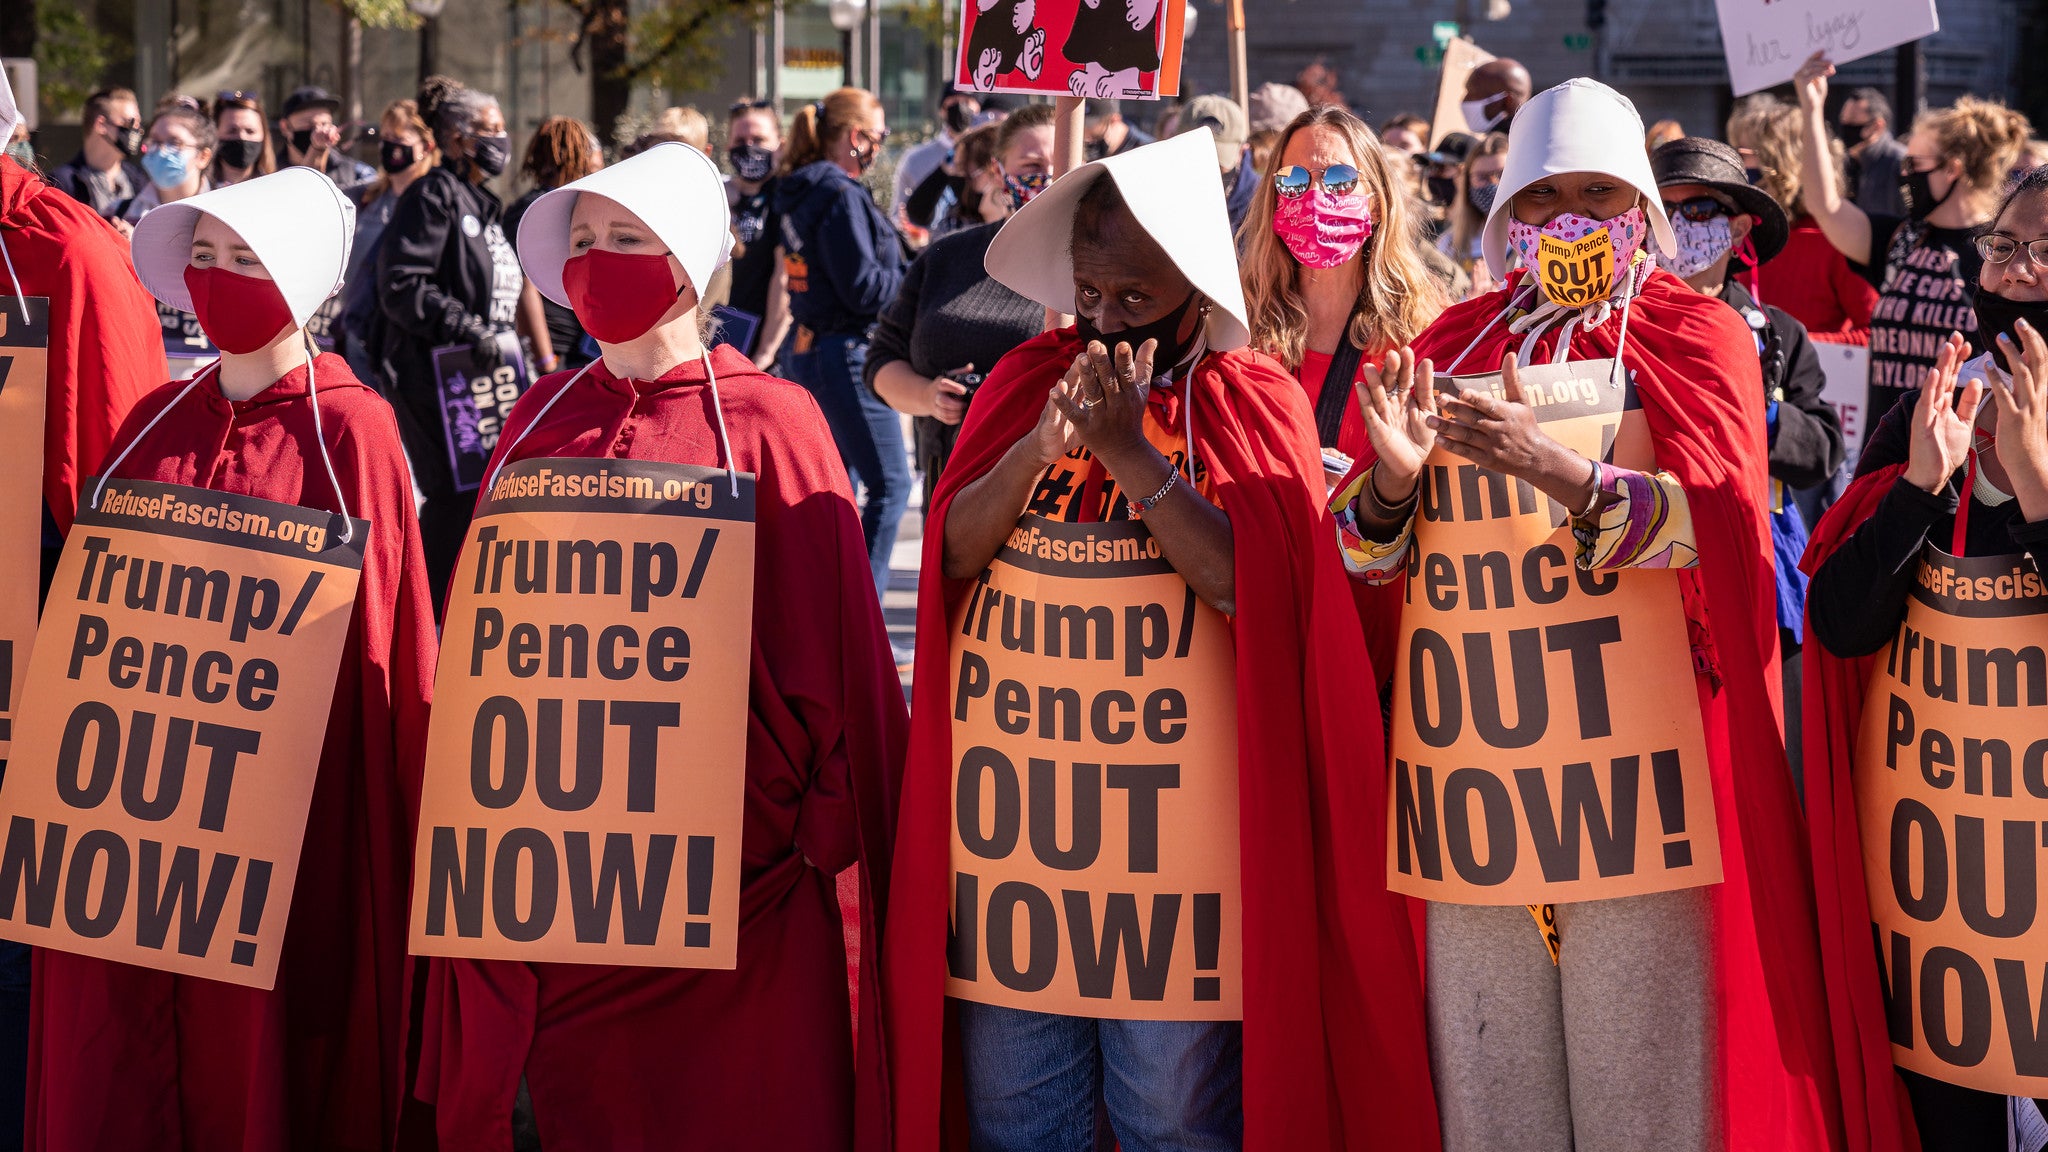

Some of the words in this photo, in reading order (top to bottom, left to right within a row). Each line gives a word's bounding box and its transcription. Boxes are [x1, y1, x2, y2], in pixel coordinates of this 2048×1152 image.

[1541, 235, 1608, 259] Trump/Pence
[1546, 273, 1612, 303] NOW
[1547, 251, 1605, 285] OUT
[1912, 301, 1978, 332] KILLED
[471, 376, 496, 409] ON
[477, 416, 500, 450] US
[101, 489, 326, 551] RefuseFascism.org
[492, 466, 713, 508] RefuseFascism.org
[76, 536, 325, 642] Trump/
[475, 526, 719, 612] Trump/
[67, 614, 279, 711] Pence
[470, 607, 691, 681] Pence
[961, 567, 1196, 677] Trump/
[954, 649, 1187, 744] Pence
[1409, 616, 1622, 748] OUT
[55, 700, 261, 832] OUT
[470, 696, 680, 814] OUT
[956, 745, 1180, 874] OUT
[1396, 749, 1693, 886] NOW!
[0, 815, 274, 967] NOW!
[425, 827, 715, 947] NOW!
[1890, 797, 2048, 939] OU
